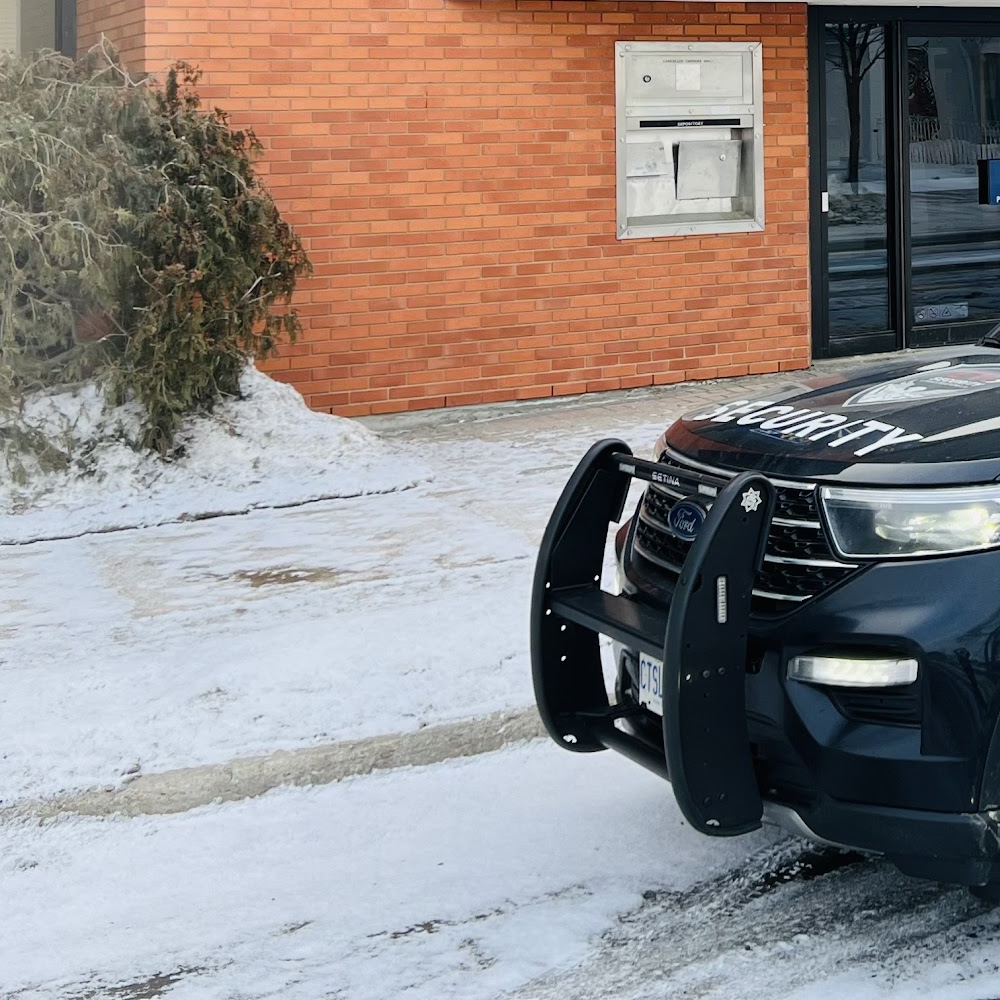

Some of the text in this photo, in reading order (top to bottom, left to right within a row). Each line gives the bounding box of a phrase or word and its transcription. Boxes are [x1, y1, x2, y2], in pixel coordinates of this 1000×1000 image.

[690, 400, 924, 457] SECURITY
[651, 470, 681, 488] SETINA
[672, 508, 697, 534] Ford
